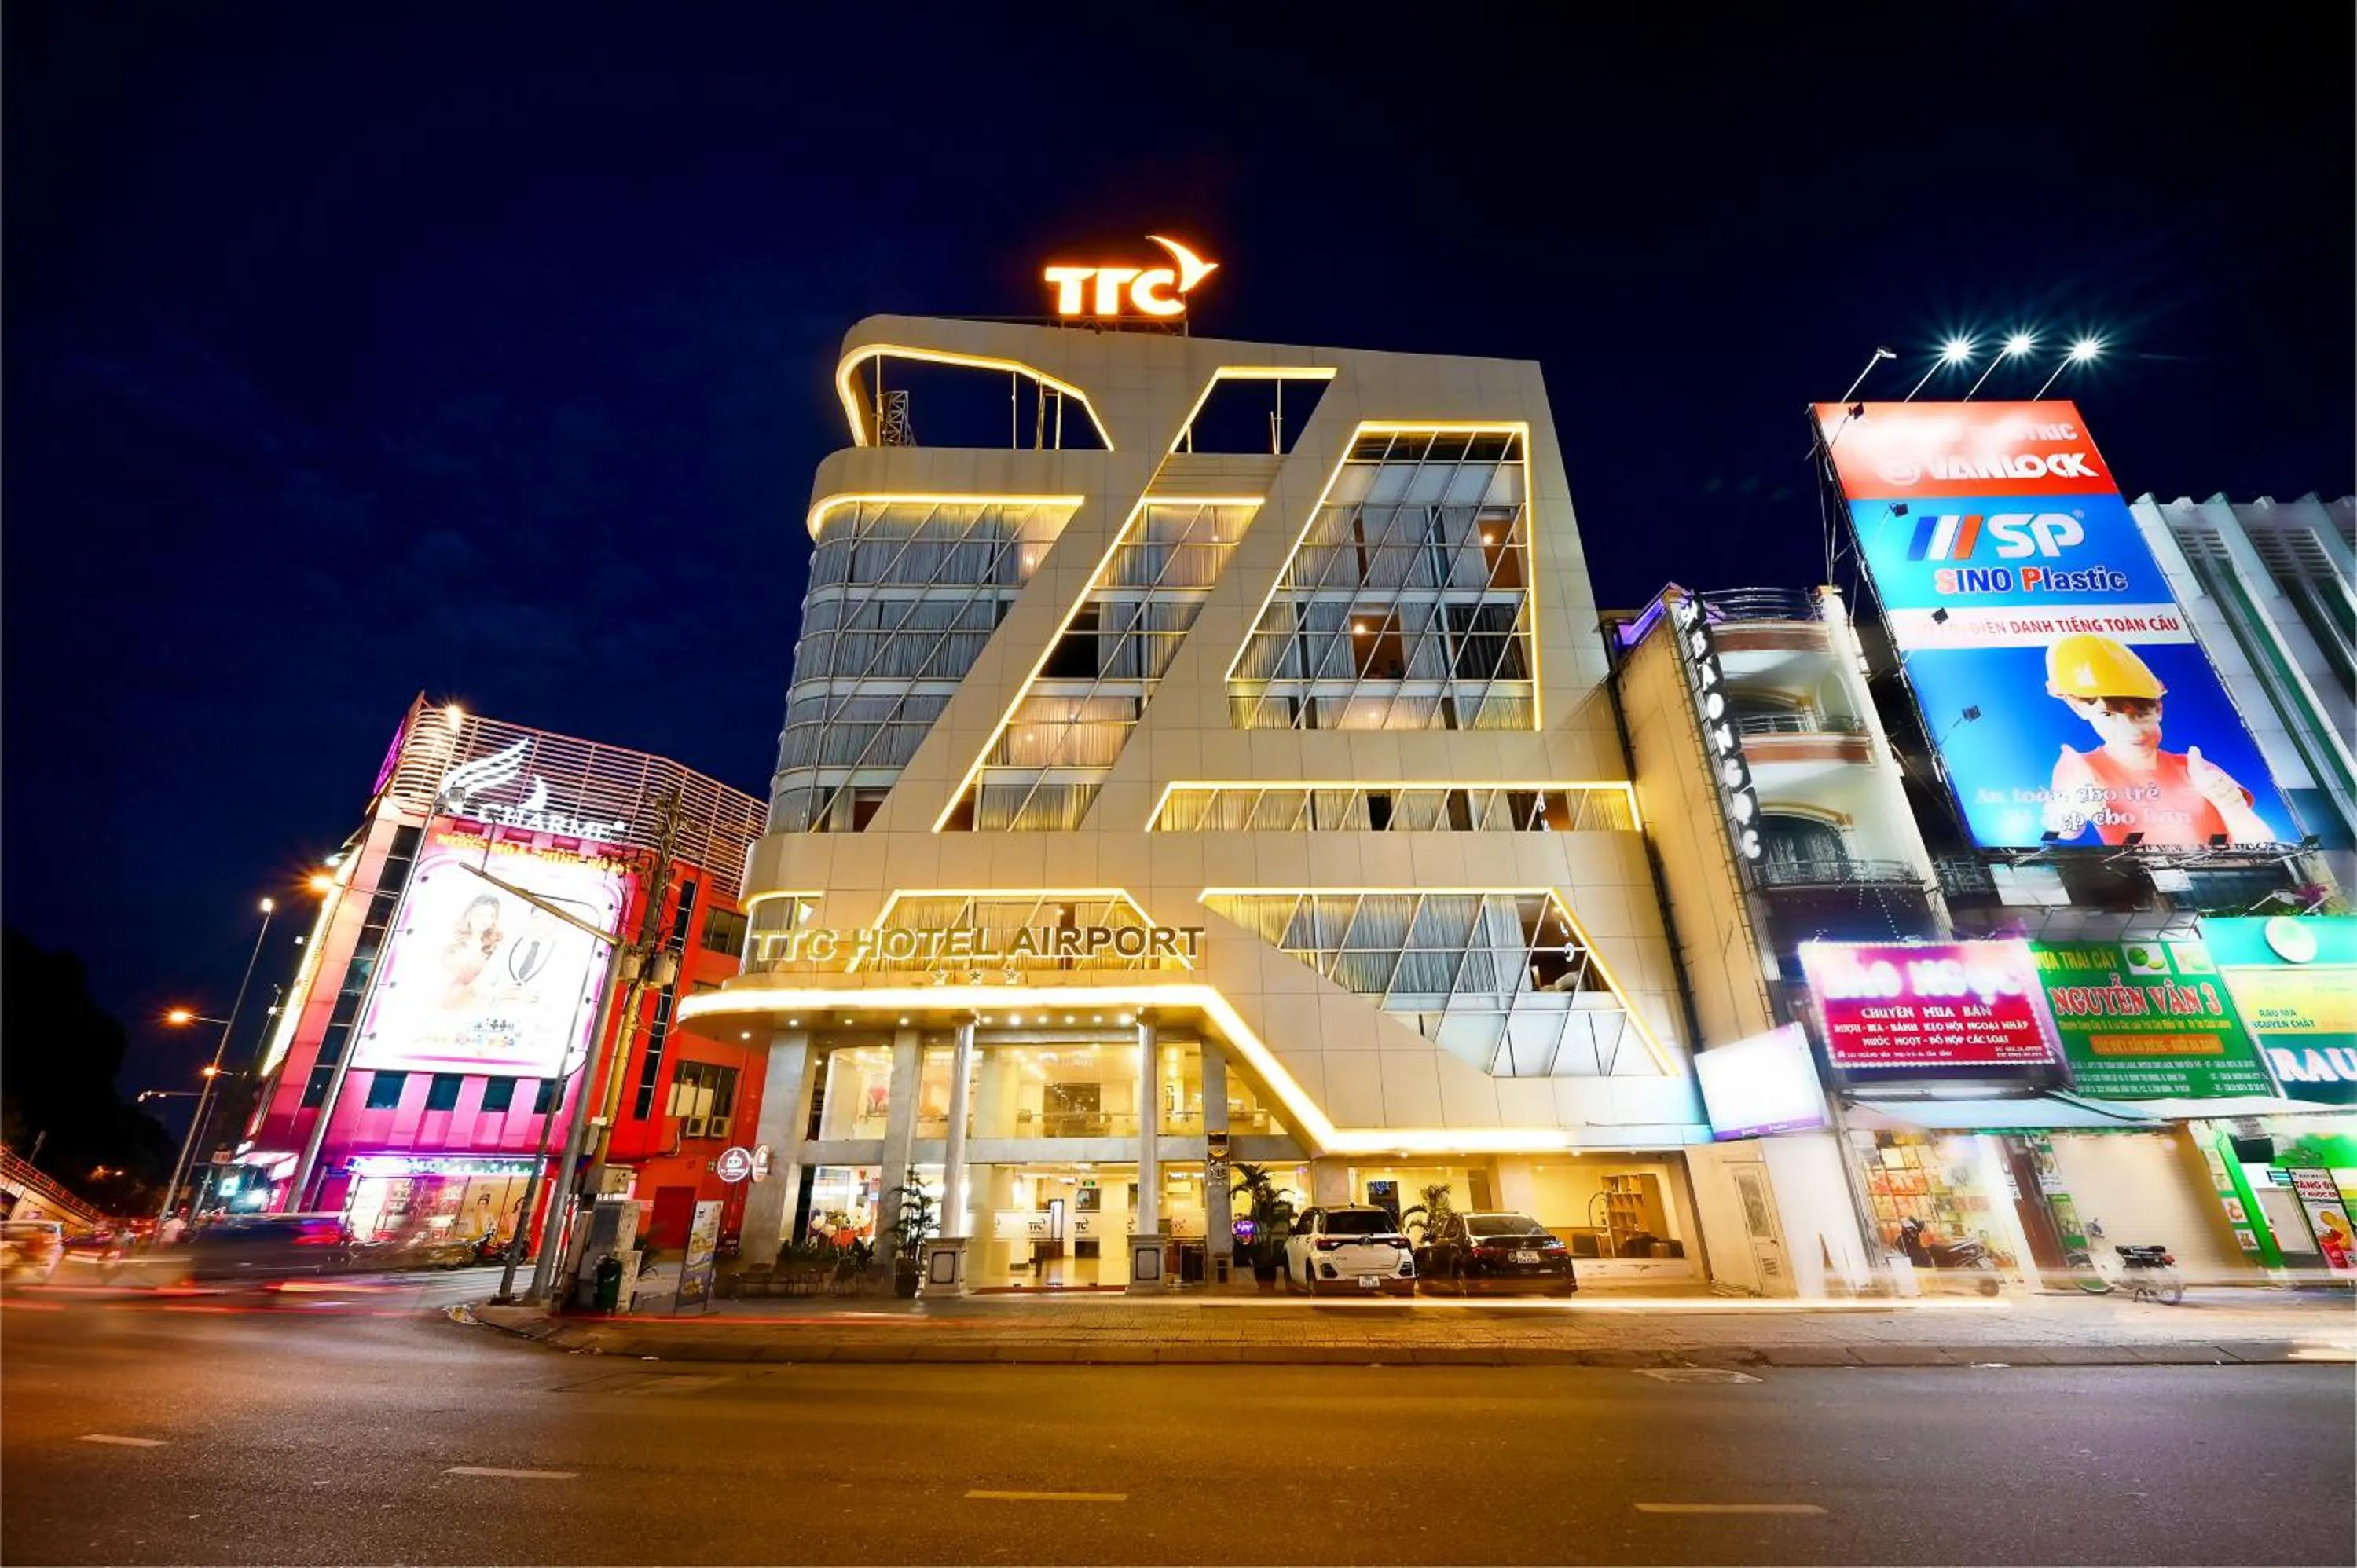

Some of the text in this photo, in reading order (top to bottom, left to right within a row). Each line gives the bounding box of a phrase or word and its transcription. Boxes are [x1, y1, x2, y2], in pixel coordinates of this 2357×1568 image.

[1044, 266, 1186, 316] TTC
[1934, 564, 2128, 595] SINO Plastic
[2009, 620, 2055, 635] DANH
[2055, 615, 2104, 633] TIẾNG
[2104, 615, 2146, 633] TOÀN
[2075, 784, 2118, 803] cho
[478, 803, 611, 842] CHARME
[2091, 808, 2137, 826] cho
[749, 925, 1206, 962] TTC HOTEL AIRPORT
[1923, 1006, 1956, 1017] MUA
[2200, 981, 2223, 1016] 3
[2267, 1048, 2357, 1082] RAU
